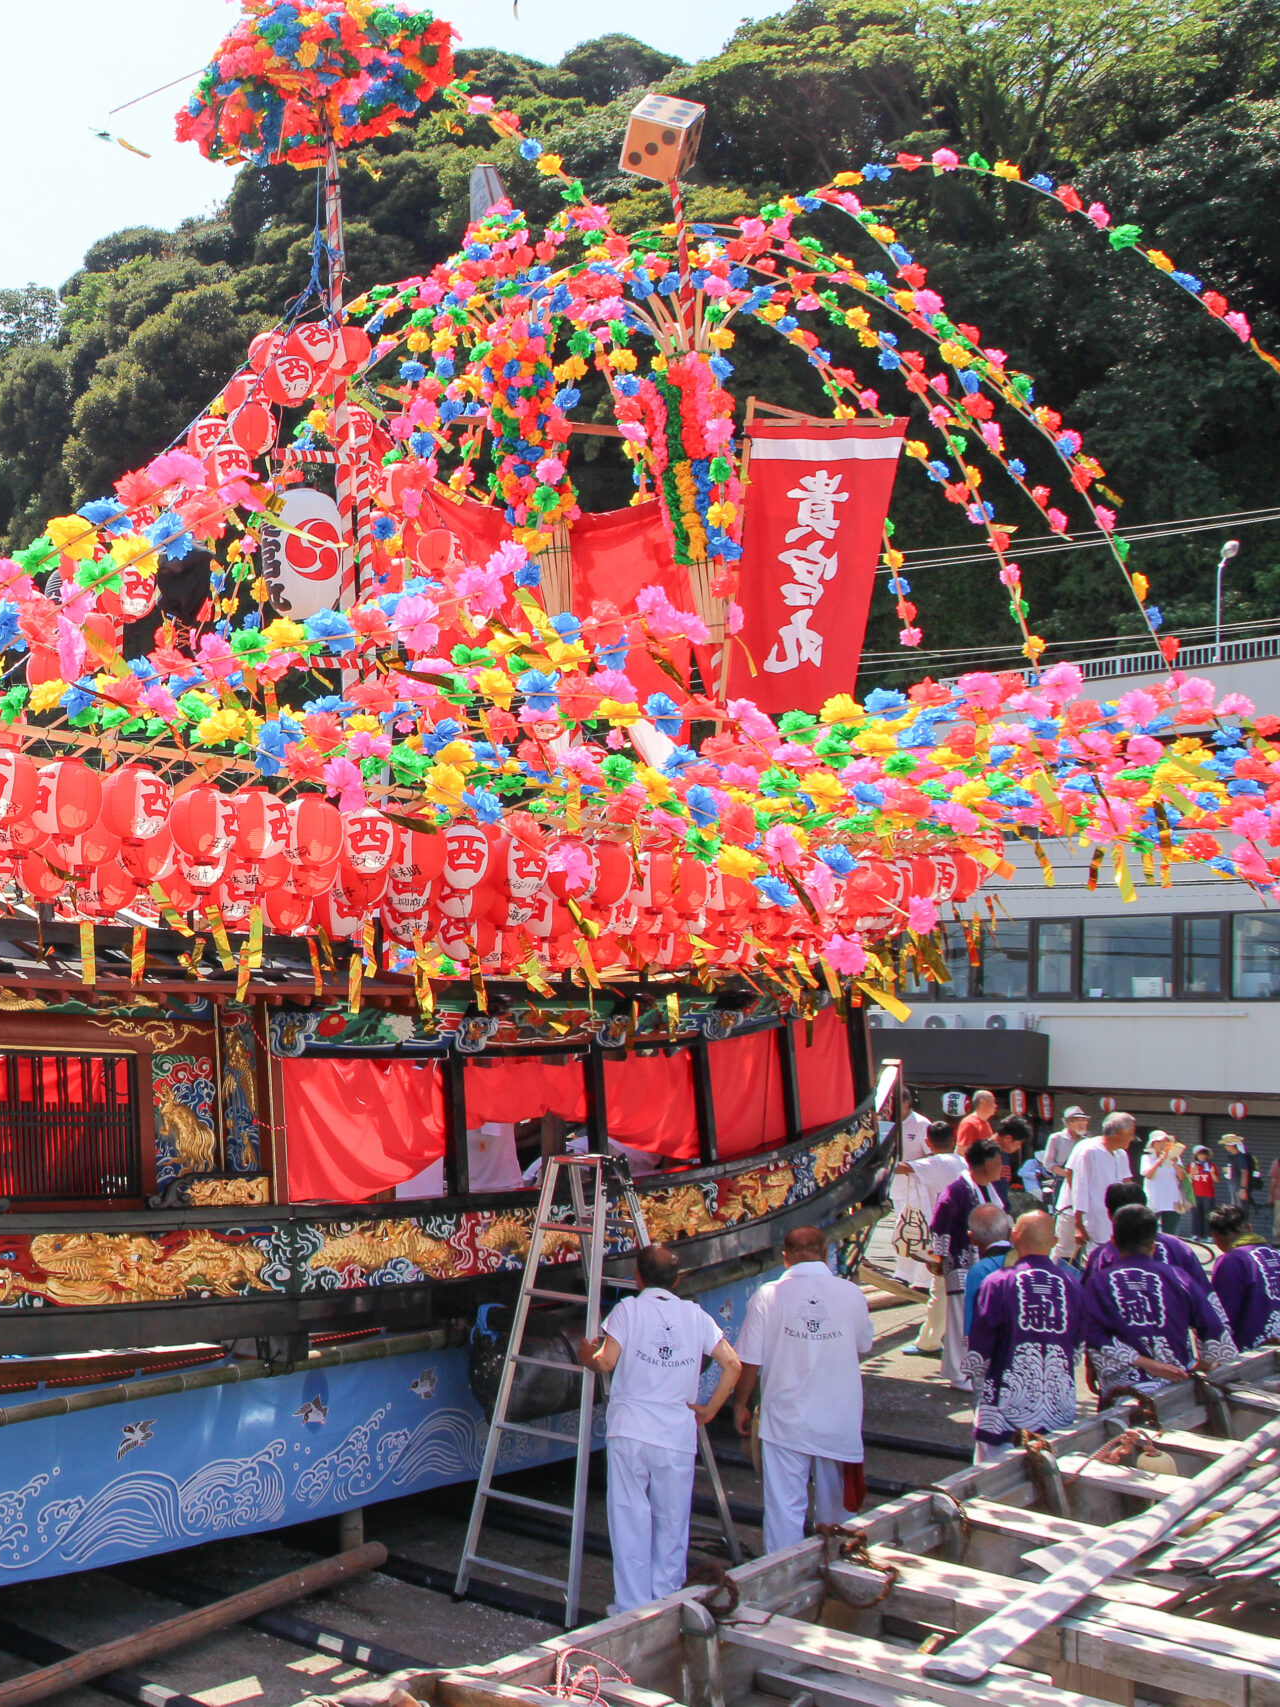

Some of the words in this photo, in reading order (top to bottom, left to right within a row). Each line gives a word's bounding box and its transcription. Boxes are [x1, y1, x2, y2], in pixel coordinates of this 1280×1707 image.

[299, 325, 330, 347] 西
[278, 358, 309, 382] 西
[141, 779, 170, 822] 西
[348, 817, 390, 854] 西
[447, 835, 486, 873] 西
[784, 1327, 808, 1341] TEAM
[810, 1330, 843, 1341] KOBAYA
[636, 1350, 660, 1367] TEAM
[661, 1357, 695, 1368] KOBAYA
